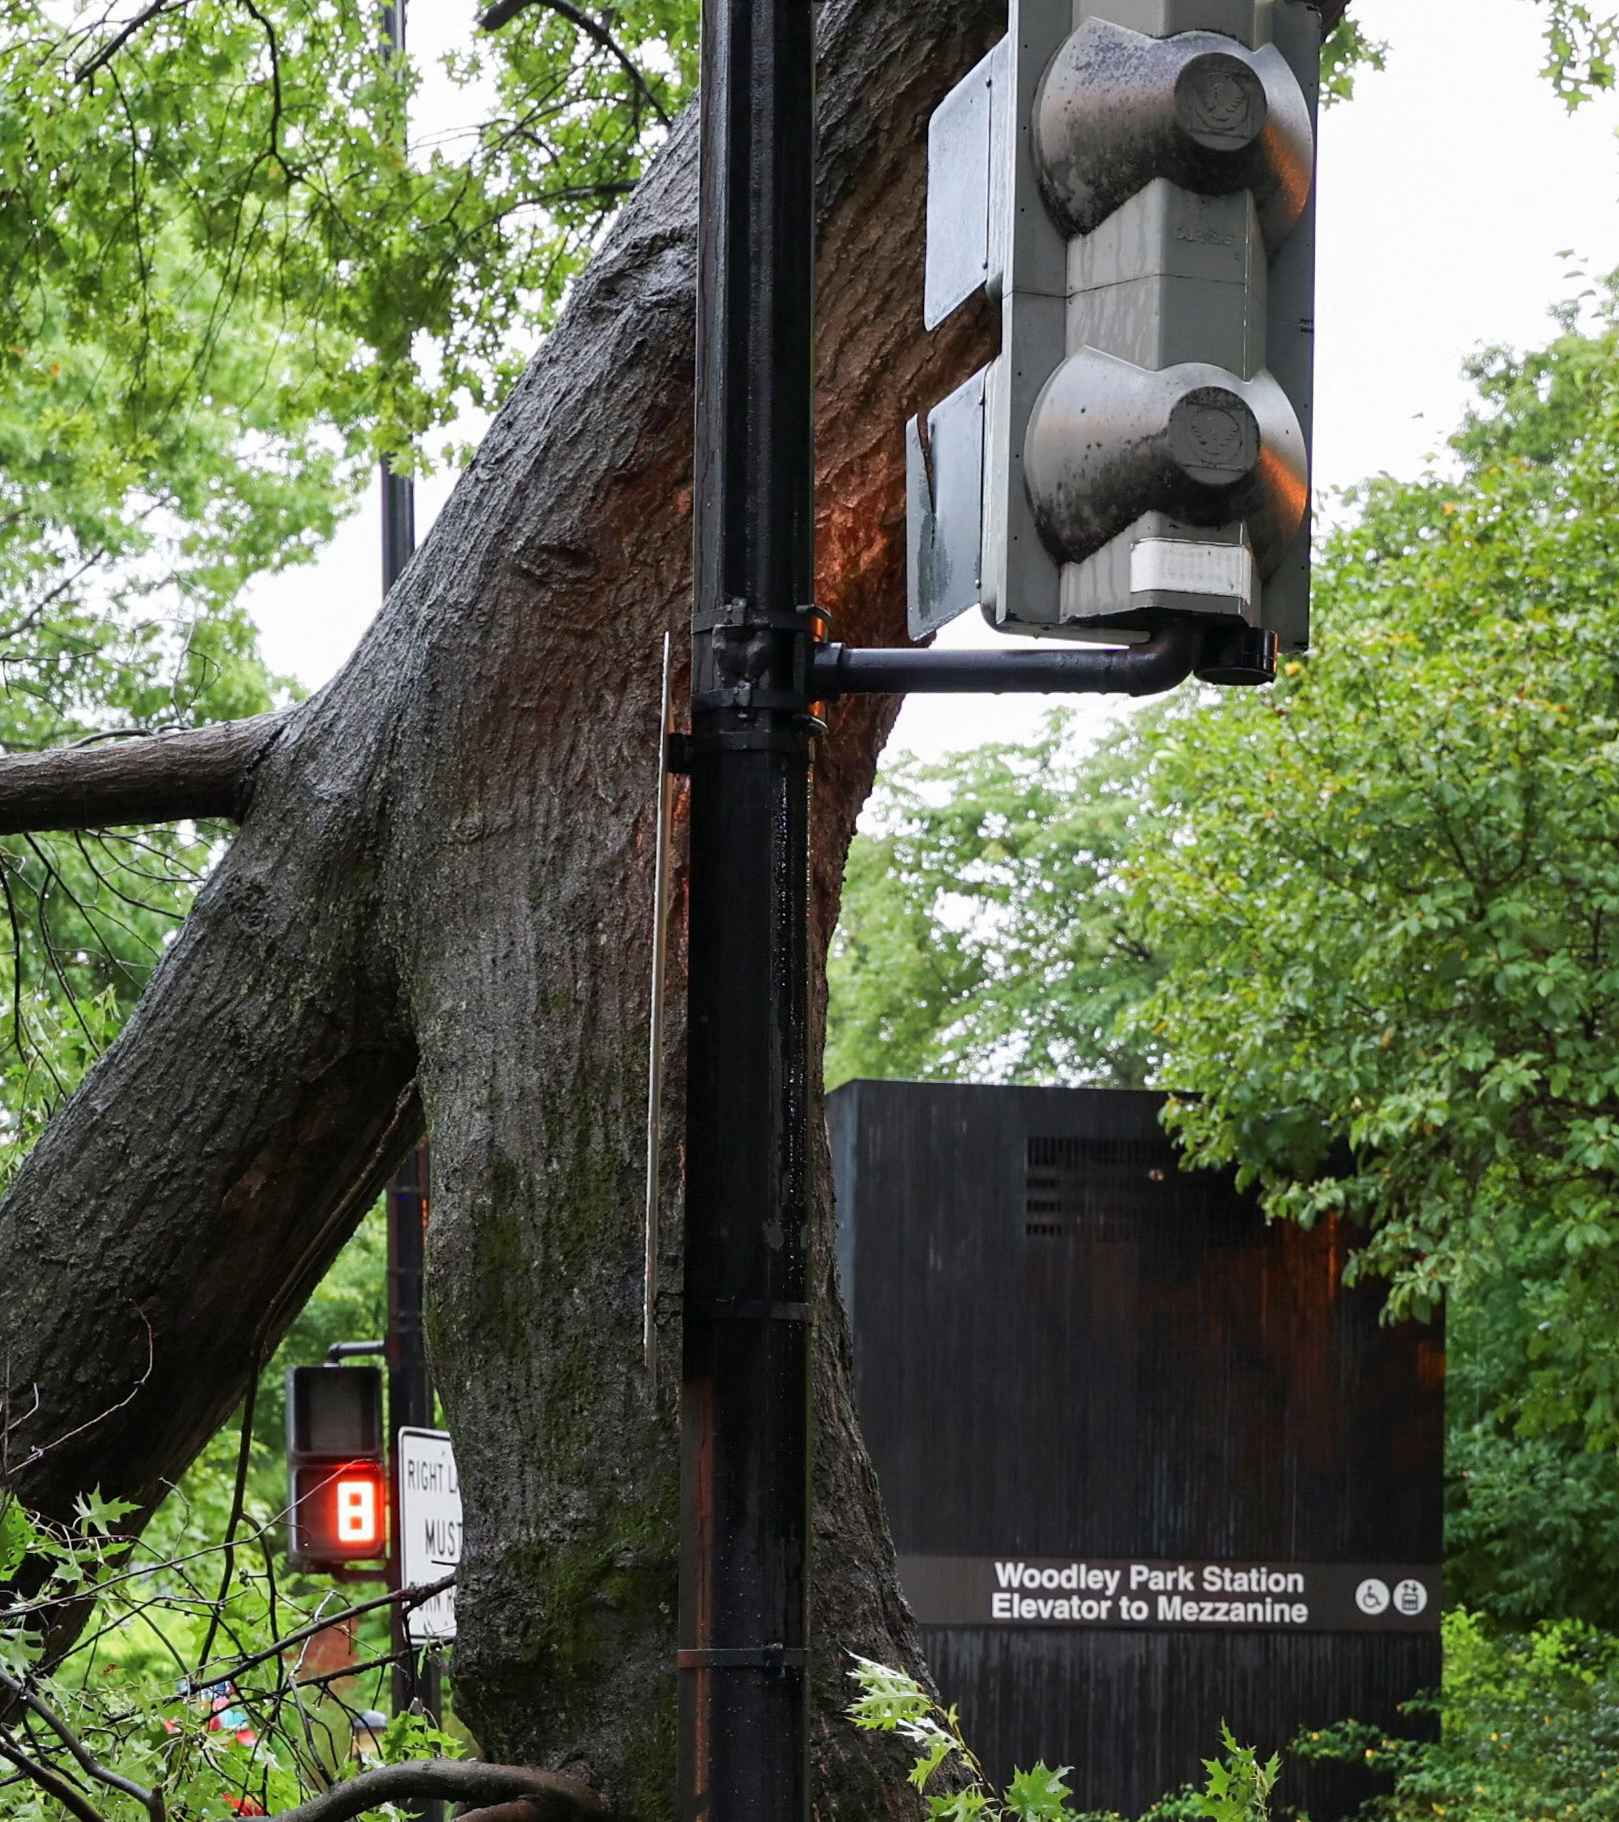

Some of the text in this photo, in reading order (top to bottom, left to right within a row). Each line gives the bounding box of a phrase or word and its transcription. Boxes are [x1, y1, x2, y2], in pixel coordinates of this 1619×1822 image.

[407, 1460, 444, 1492] RIGHT
[337, 1481, 375, 1542] 8
[425, 1519, 463, 1556] MUST
[993, 1561, 1305, 1597] Woodley Park Station
[991, 1592, 1309, 1624] Elevator to Mezzanine
